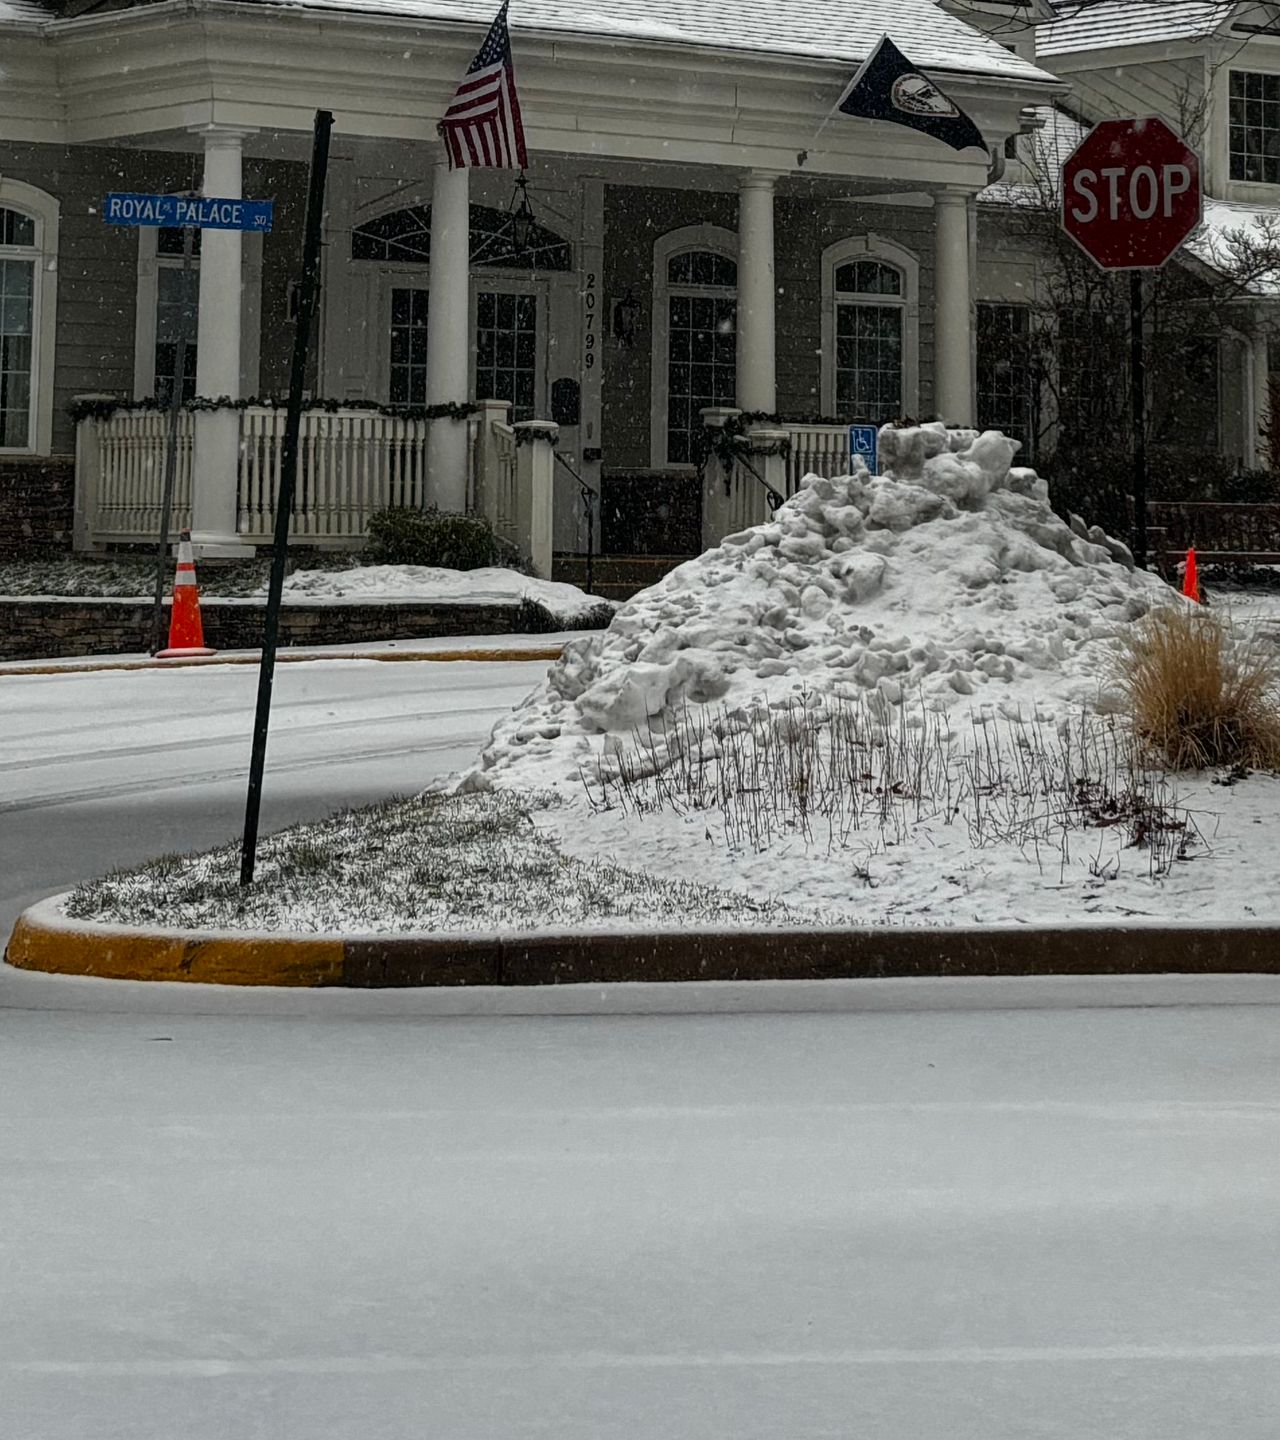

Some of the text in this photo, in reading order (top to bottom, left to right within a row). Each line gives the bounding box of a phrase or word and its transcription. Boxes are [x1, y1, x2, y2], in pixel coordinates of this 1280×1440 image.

[109, 198, 166, 221] ROYAL
[175, 201, 242, 224] PALACE
[1071, 164, 1191, 223] STOP
[585, 273, 595, 369] 20799
